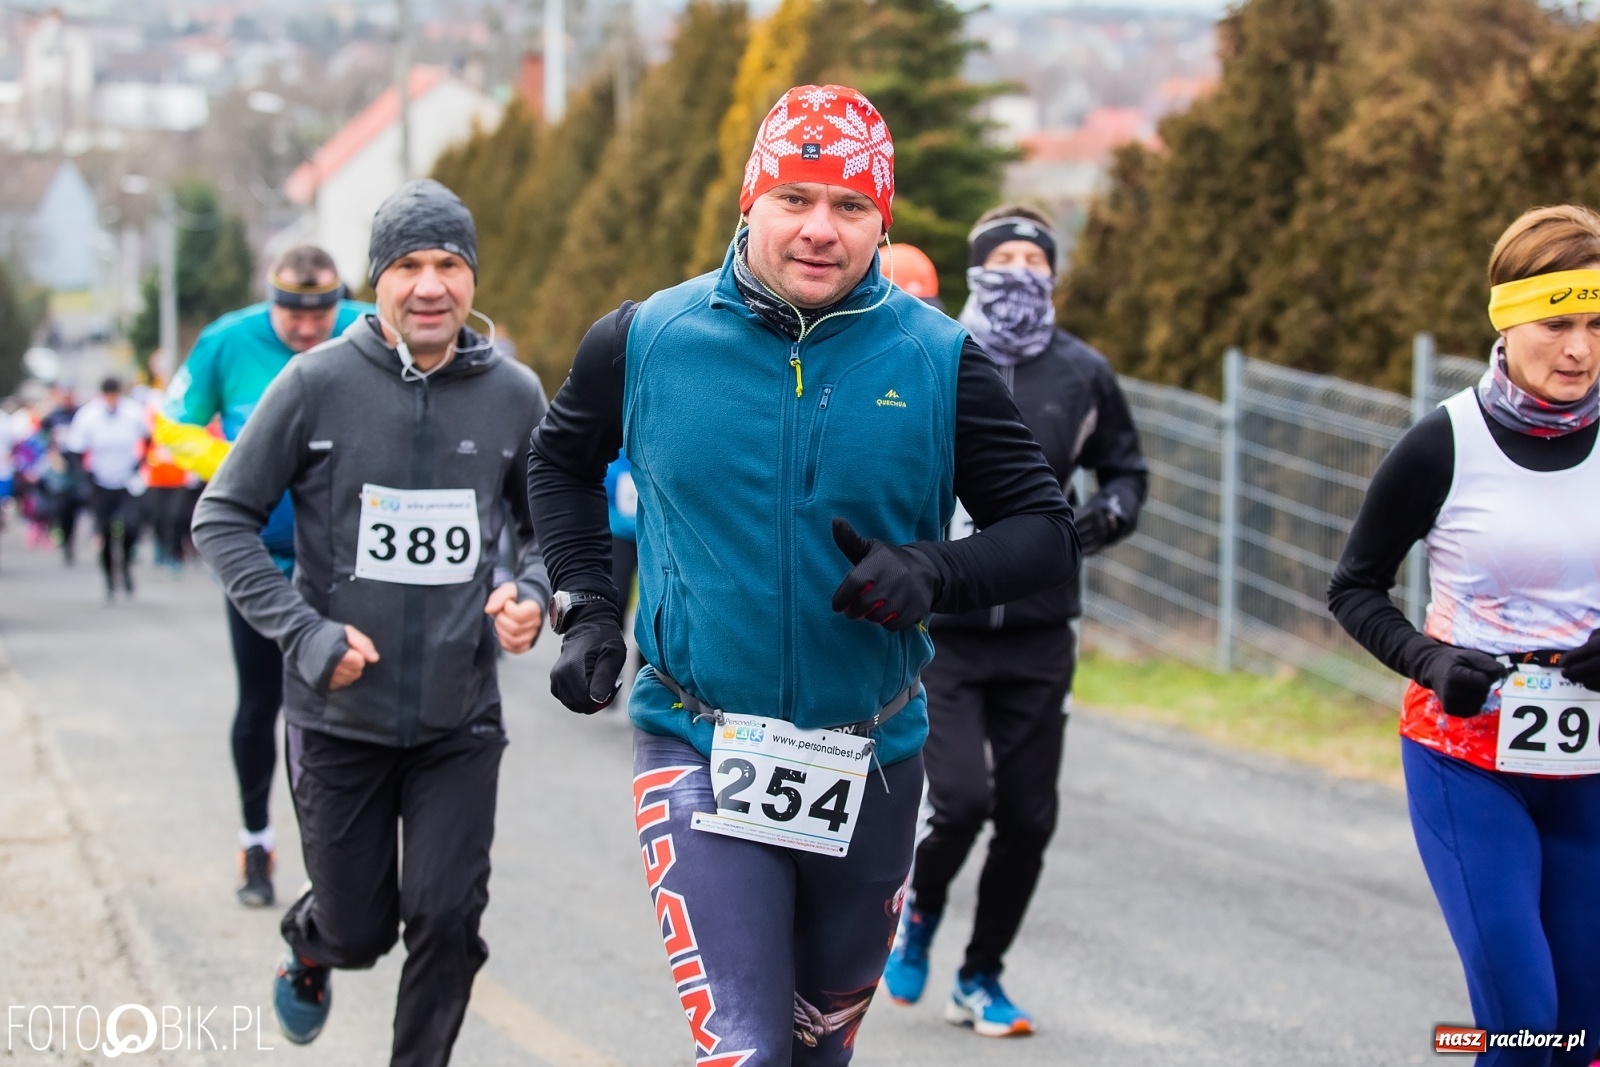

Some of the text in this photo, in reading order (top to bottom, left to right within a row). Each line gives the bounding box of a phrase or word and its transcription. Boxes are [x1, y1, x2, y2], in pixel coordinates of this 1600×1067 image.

[1577, 289, 1600, 299] as
[876, 399, 907, 408] QUECHUA
[368, 523, 471, 565] 389
[725, 717, 765, 729] PersonalBes
[1508, 705, 1600, 754] 29
[772, 734, 864, 761] www.personalbest.pl
[716, 757, 852, 833] 254
